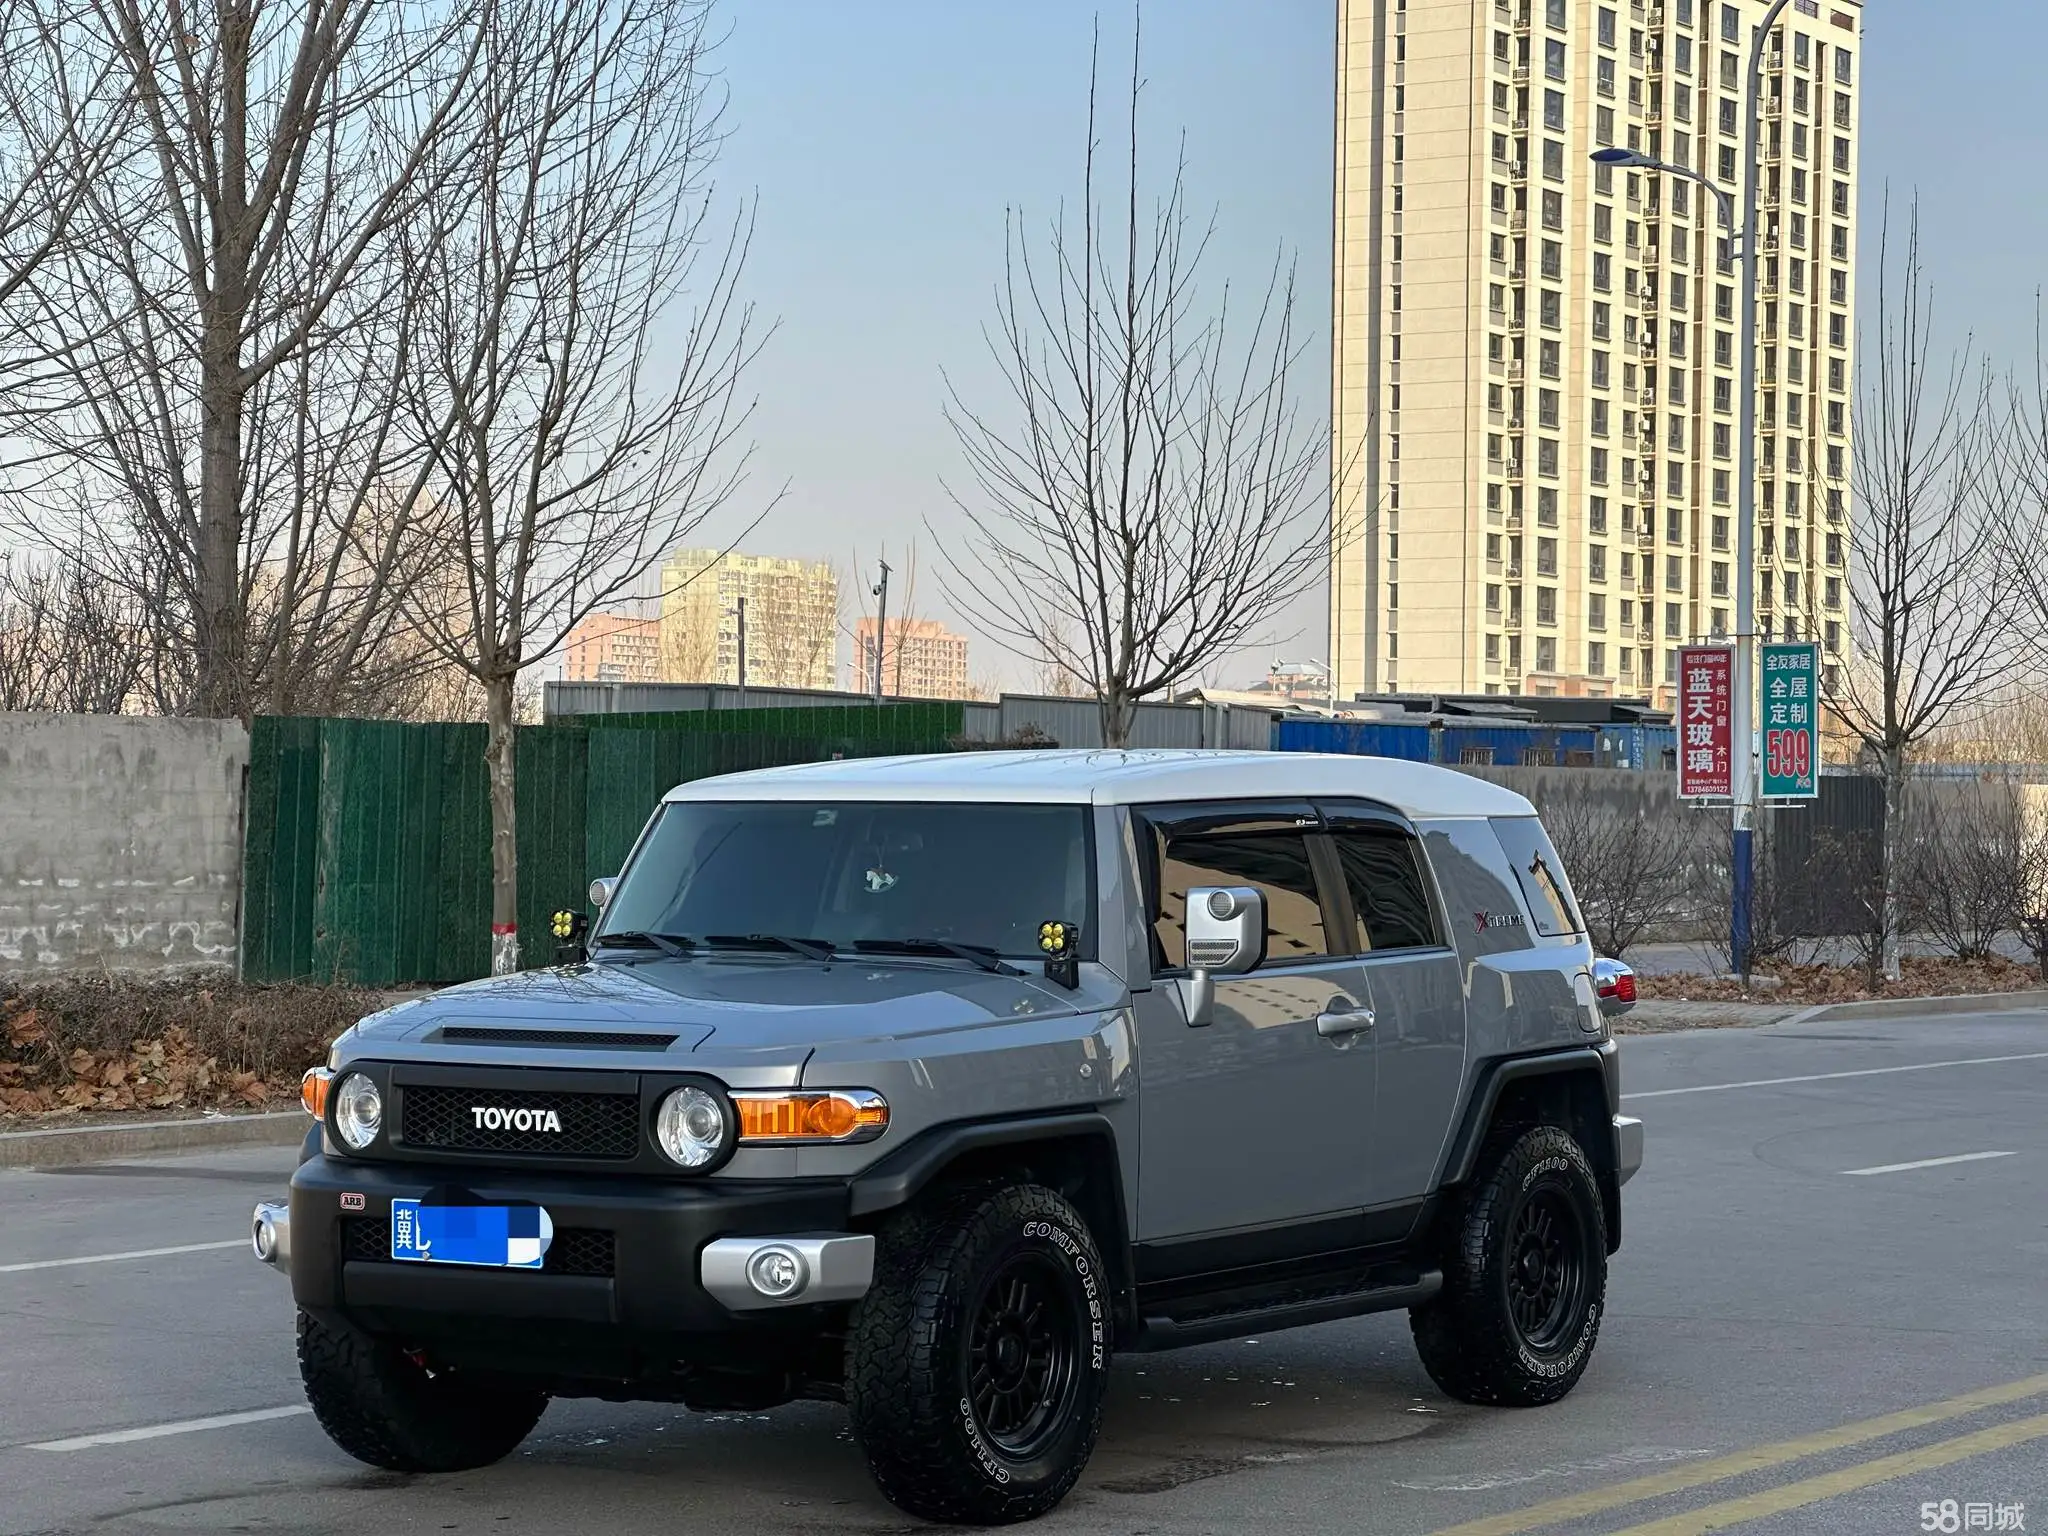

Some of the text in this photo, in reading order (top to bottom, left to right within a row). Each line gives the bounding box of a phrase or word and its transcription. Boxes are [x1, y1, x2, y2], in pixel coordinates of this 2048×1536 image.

[1716, 669, 1727, 727] 系统门窗
[1769, 676, 1808, 699] 全屋
[1686, 668, 1714, 774] 蓝天玻璃
[1769, 702, 1808, 725] 定制
[1716, 745, 1727, 774] 木门
[1767, 728, 1811, 778] 599
[471, 1106, 563, 1133] TOYOTA
[342, 1195, 364, 1207] ARB
[1023, 1221, 1103, 1369] COMFORSER
[1519, 1303, 1597, 1378] COMFORSER
[959, 1398, 1010, 1484] CF1100
